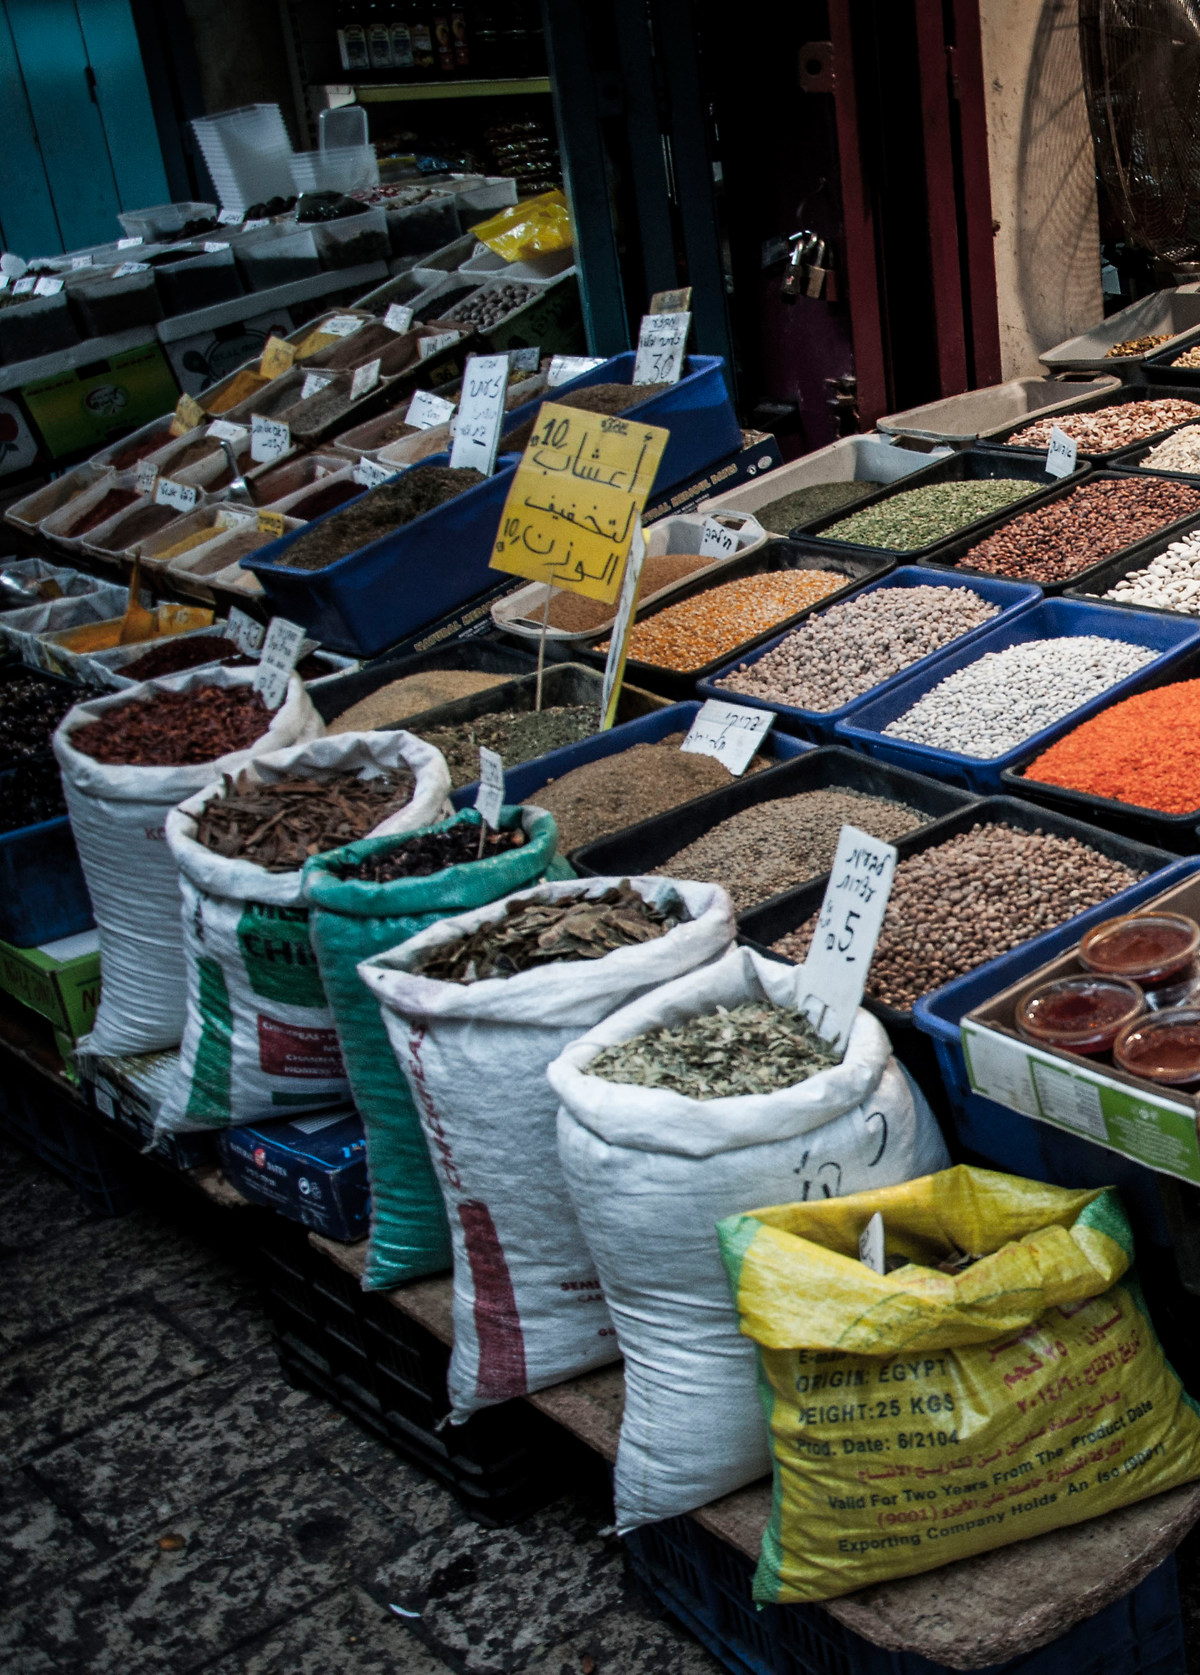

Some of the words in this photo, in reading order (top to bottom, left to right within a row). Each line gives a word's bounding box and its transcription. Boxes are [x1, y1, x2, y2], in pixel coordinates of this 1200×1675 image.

[652, 352, 673, 381] 30
[533, 431, 653, 493] أعشاب
[524, 496, 636, 543] لتخفيف
[523, 525, 619, 586] الوزن
[878, 1357, 947, 1384] EGYPT
[910, 1393, 956, 1415] KGS
[828, 1495, 867, 1510] Valid
[870, 1493, 899, 1508] For
[903, 1488, 938, 1502] Two
[941, 1480, 989, 1497] Years
[992, 1461, 1034, 1486] From
[1036, 1446, 1064, 1466] The
[1071, 1415, 1127, 1450] Product
[1126, 1400, 1154, 1424] Date
[843, 1437, 891, 1455] Date:
[897, 1429, 961, 1450] 6/2104
[838, 1532, 922, 1554] Exporting
[926, 1513, 1004, 1540] Company
[1011, 1491, 1058, 1516] Holds
[1068, 1480, 1089, 1496] An
